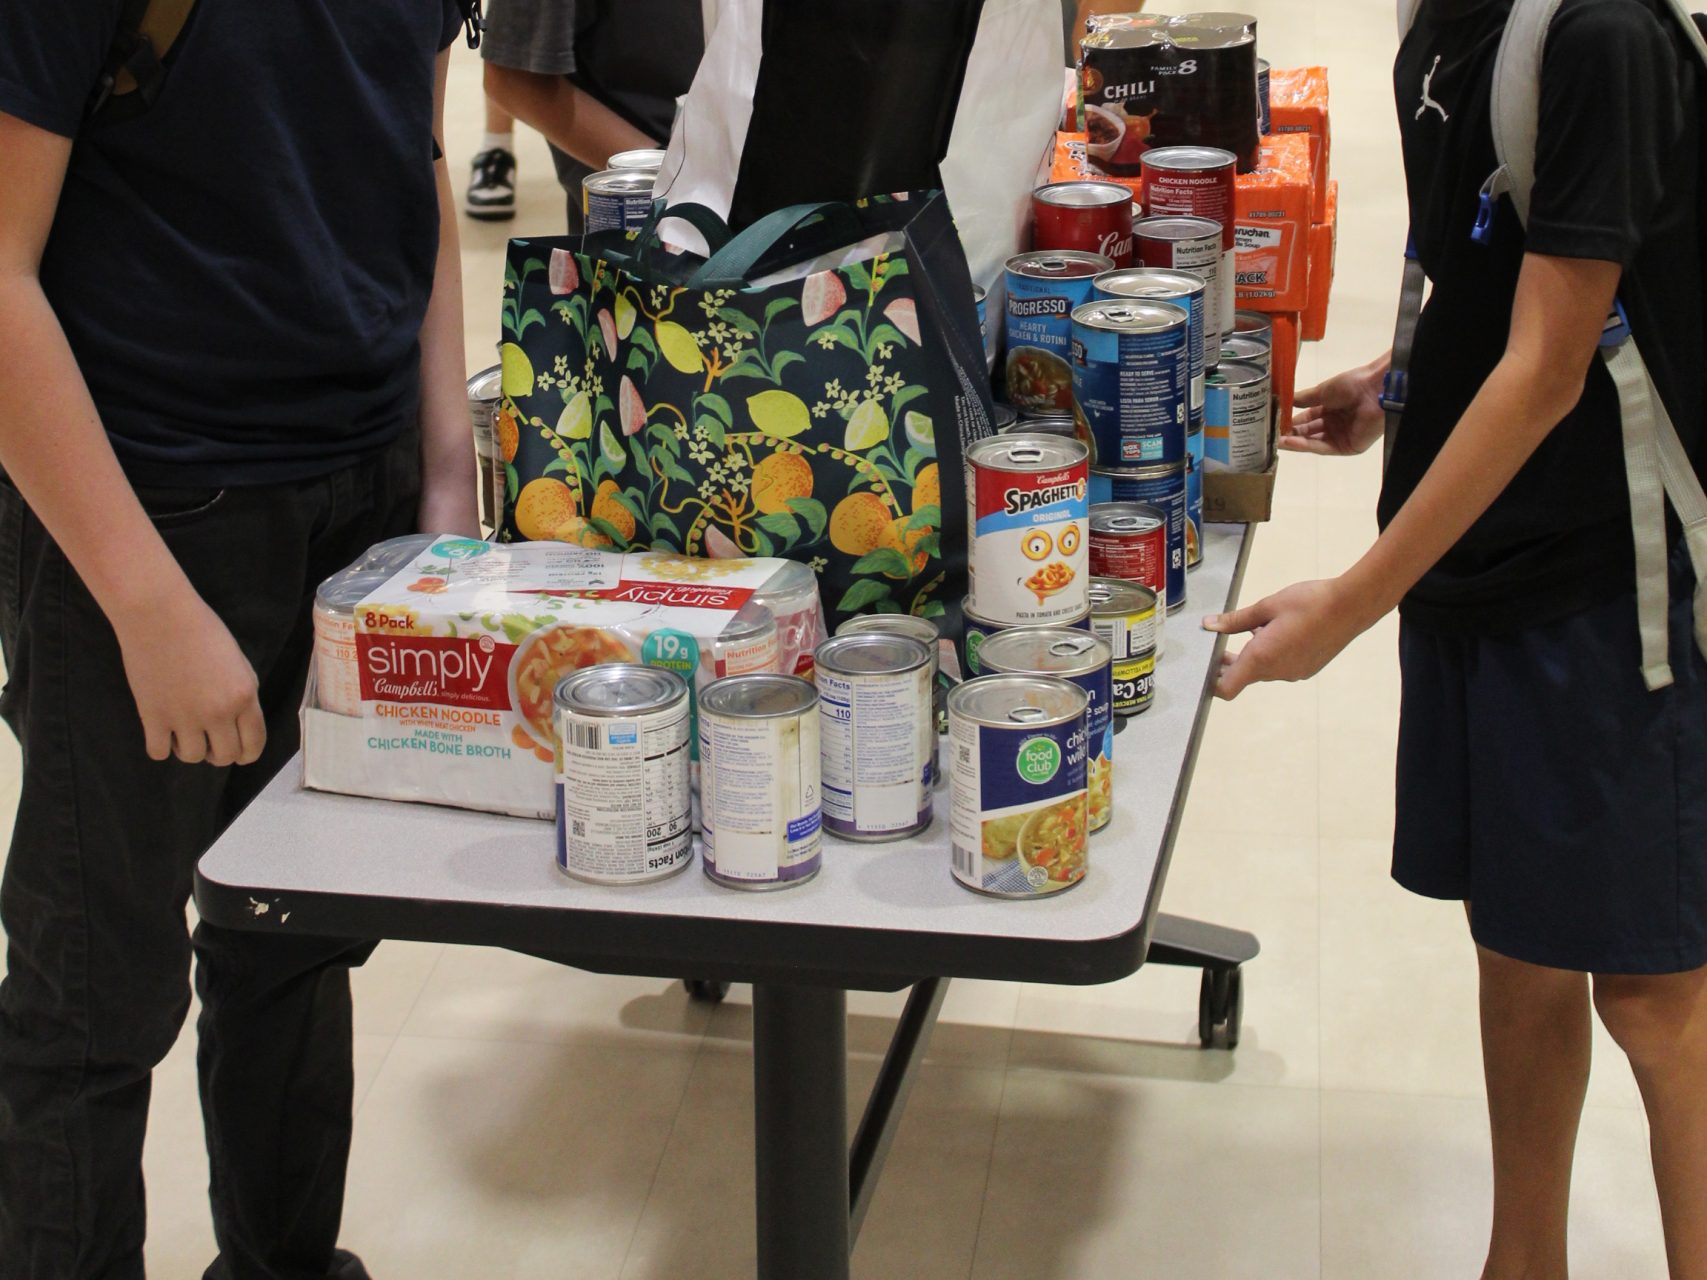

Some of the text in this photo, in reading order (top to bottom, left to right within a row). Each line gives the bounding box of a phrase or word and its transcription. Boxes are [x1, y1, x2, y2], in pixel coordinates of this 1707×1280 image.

[1178, 59, 1198, 75] 8
[1104, 80, 1155, 99] CHILI
[1158, 177, 1218, 185] CHICKEN NOODLE
[1176, 246, 1204, 255] Nutrition
[1008, 299, 1067, 317] PROGRESSO
[1019, 320, 1047, 333] HEARTY
[1032, 331, 1039, 342] &
[1040, 334, 1067, 345] ROTINI
[1232, 390, 1261, 401] Nutrition
[954, 395, 962, 413] Made
[1032, 509, 1073, 523] ORIGINAL
[616, 586, 729, 606] simply
[365, 611, 377, 628] 8
[379, 614, 415, 630] Pack
[1016, 611, 1029, 619] PASTA
[726, 644, 767, 659] Nutrition
[367, 641, 493, 692] simply
[829, 679, 851, 690] Facts
[1112, 682, 1136, 699] Ca
[375, 703, 502, 727] CHICKEN NOODLE
[835, 708, 851, 719] 110
[449, 723, 476, 732] CHICKEN
[414, 729, 463, 742] MADE WITH
[367, 736, 511, 759] CHICKEN BONE BROTH
[1025, 747, 1053, 762] food
[1026, 761, 1052, 774] club
[646, 821, 678, 838] 90 200
[648, 853, 674, 869] Facts
